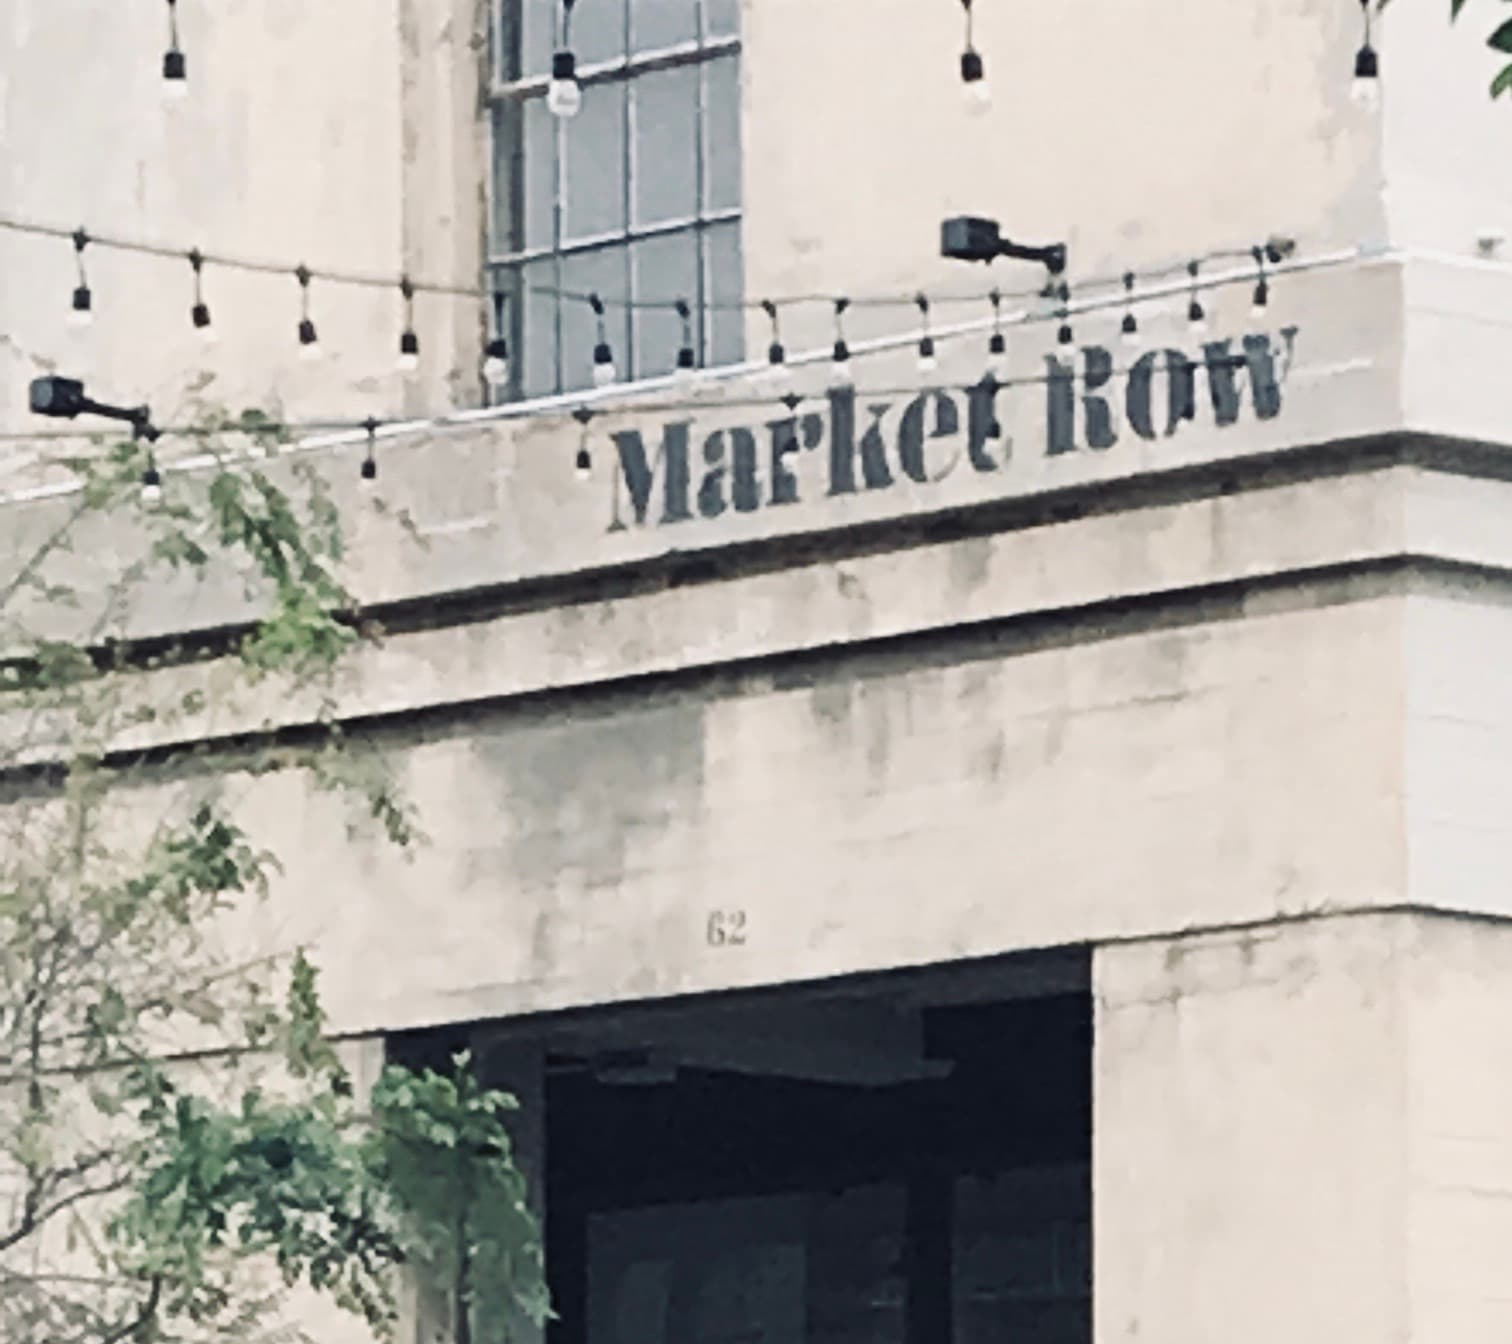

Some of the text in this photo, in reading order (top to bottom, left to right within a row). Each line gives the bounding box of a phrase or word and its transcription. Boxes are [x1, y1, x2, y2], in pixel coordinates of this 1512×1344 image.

[605, 327, 1298, 532] Market Row
[707, 910, 745, 947] 62
